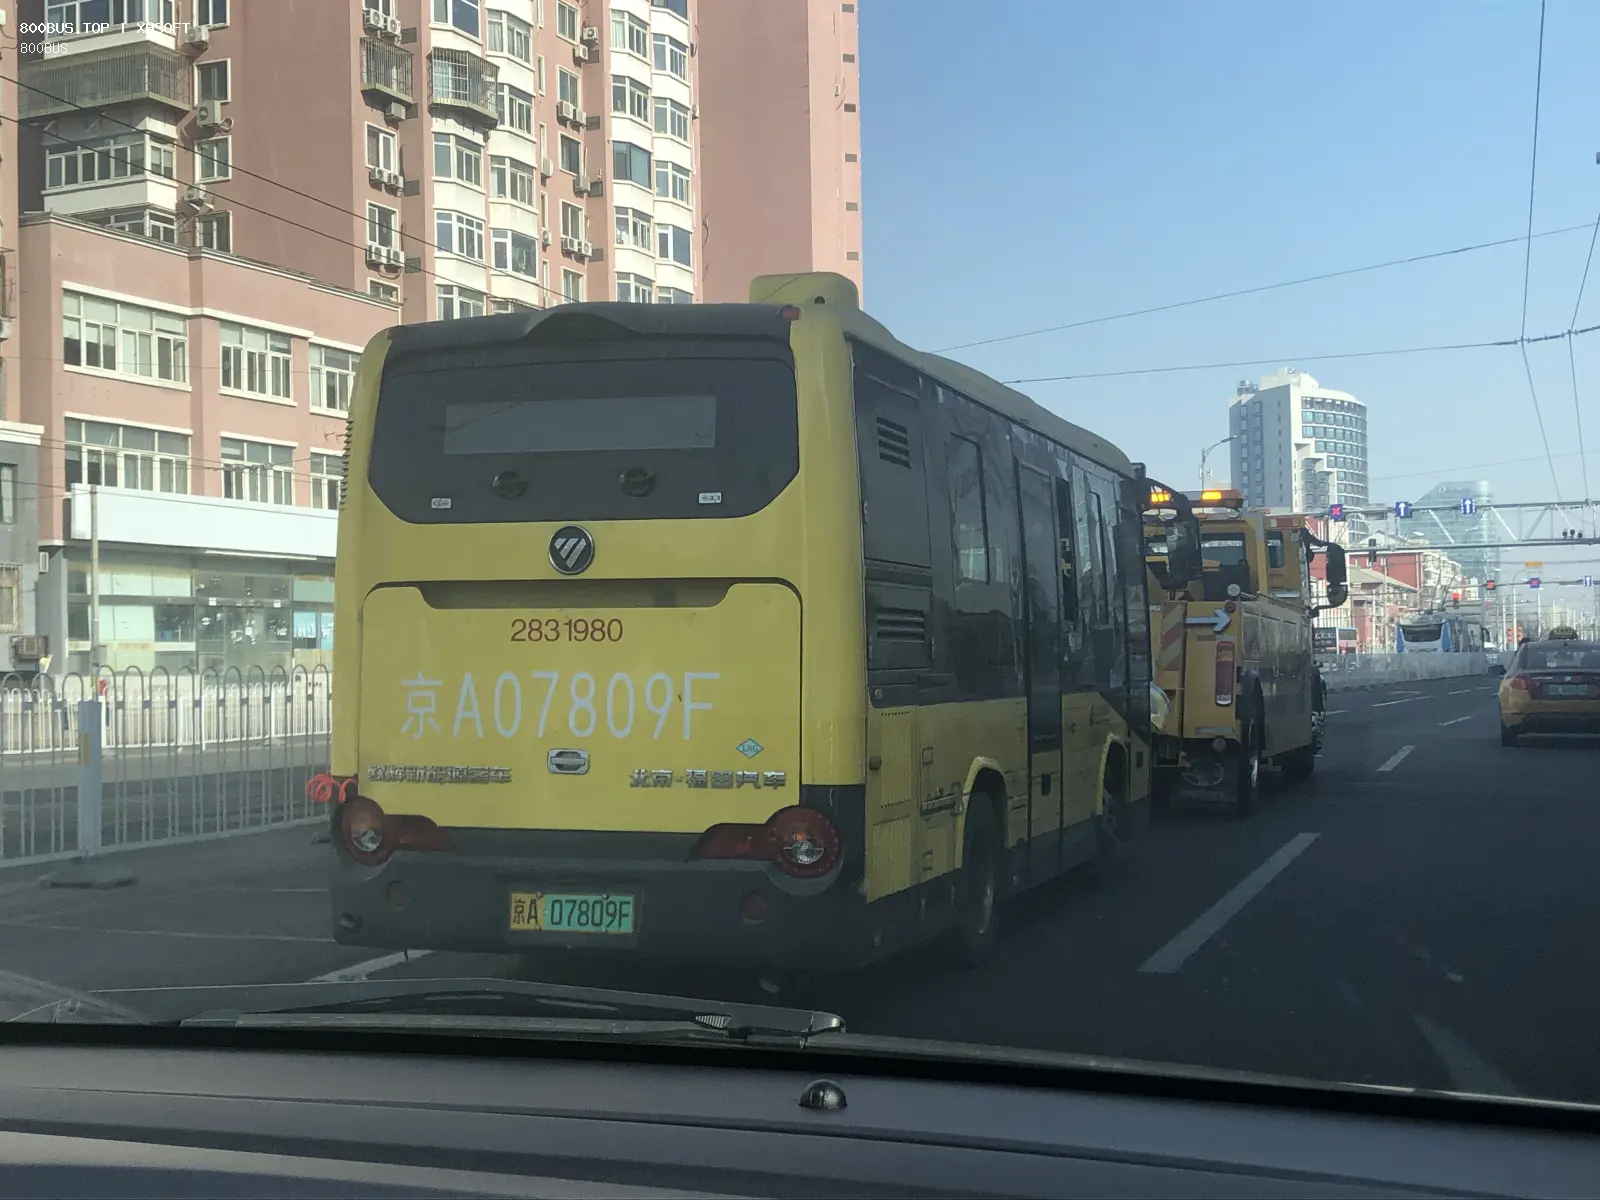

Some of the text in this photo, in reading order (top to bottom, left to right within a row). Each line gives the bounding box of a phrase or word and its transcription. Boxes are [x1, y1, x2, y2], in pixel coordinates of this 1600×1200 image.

[510, 618, 624, 642] 2831980
[401, 671, 720, 740] 京A07809F
[741, 744, 759, 753] LNG
